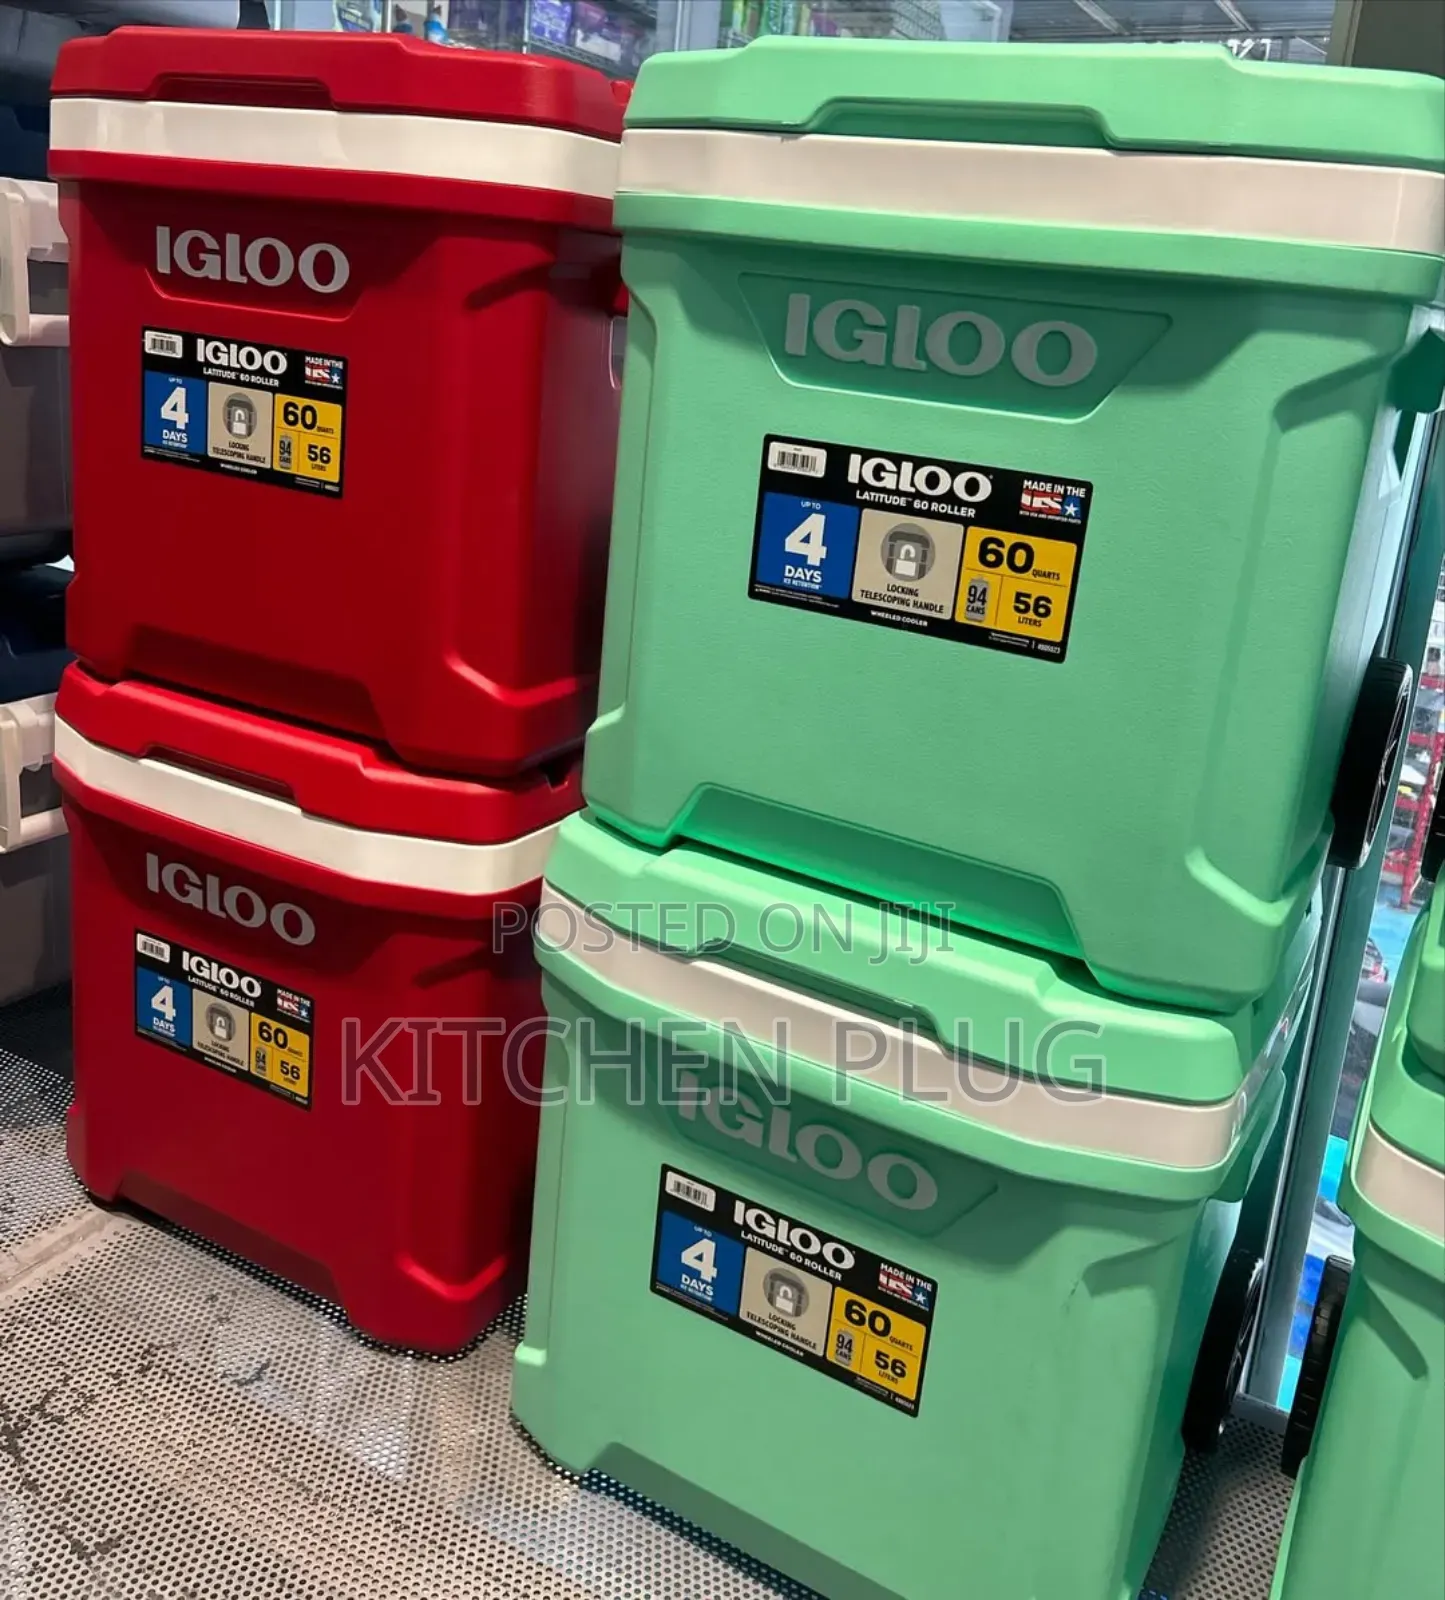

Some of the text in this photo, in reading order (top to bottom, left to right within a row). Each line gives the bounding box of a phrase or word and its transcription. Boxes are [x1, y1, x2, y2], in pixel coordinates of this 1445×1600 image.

[157, 226, 349, 294] IGLOO
[785, 294, 1097, 386] IGLOO
[196, 338, 287, 375] IGLOO
[240, 373, 249, 382] 60
[250, 374, 279, 388] ROLLER
[160, 386, 189, 430] 4
[283, 401, 317, 430] 60
[162, 430, 188, 443] DAYS
[279, 439, 291, 456] 94
[308, 444, 331, 464] 56
[848, 453, 992, 502] IGLOO
[1023, 480, 1086, 498] MADE IN THE
[801, 500, 822, 510] UP TO
[913, 499, 929, 510] 60
[931, 503, 976, 518] ROLLER
[785, 513, 827, 567] 4
[978, 536, 1060, 581] 60 QUARTS
[784, 565, 822, 583] DAYS
[860, 589, 944, 613] TELESCOPING HANDLE
[887, 583, 919, 597] LOCKING
[967, 585, 987, 606] 94
[966, 604, 986, 615] CANS
[1013, 591, 1053, 618] 56
[870, 610, 928, 627] WHEELED COOLER
[1017, 616, 1042, 628] LITERS
[146, 852, 316, 946] IGLOO
[182, 950, 261, 998] IGLOO
[151, 985, 176, 1022] 4
[230, 991, 255, 1008] ROLLER
[153, 1016, 176, 1033] DAYS
[258, 1021, 288, 1050] 60
[280, 1059, 300, 1080] 56
[678, 1070, 938, 1210] IGLOO
[734, 1200, 855, 1269] IGLOO
[681, 1238, 717, 1283] 4
[804, 1258, 842, 1281] ROLLER
[681, 1273, 714, 1296] DAYS
[880, 1262, 932, 1292] MADE IN THE
[769, 1312, 796, 1331] LOCKING
[844, 1299, 892, 1337] 60
[747, 1311, 817, 1350] TELESCOPING HANDLE
[836, 1333, 853, 1353] 94
[874, 1349, 907, 1379] 56
[878, 1370, 899, 1384] LITERS
